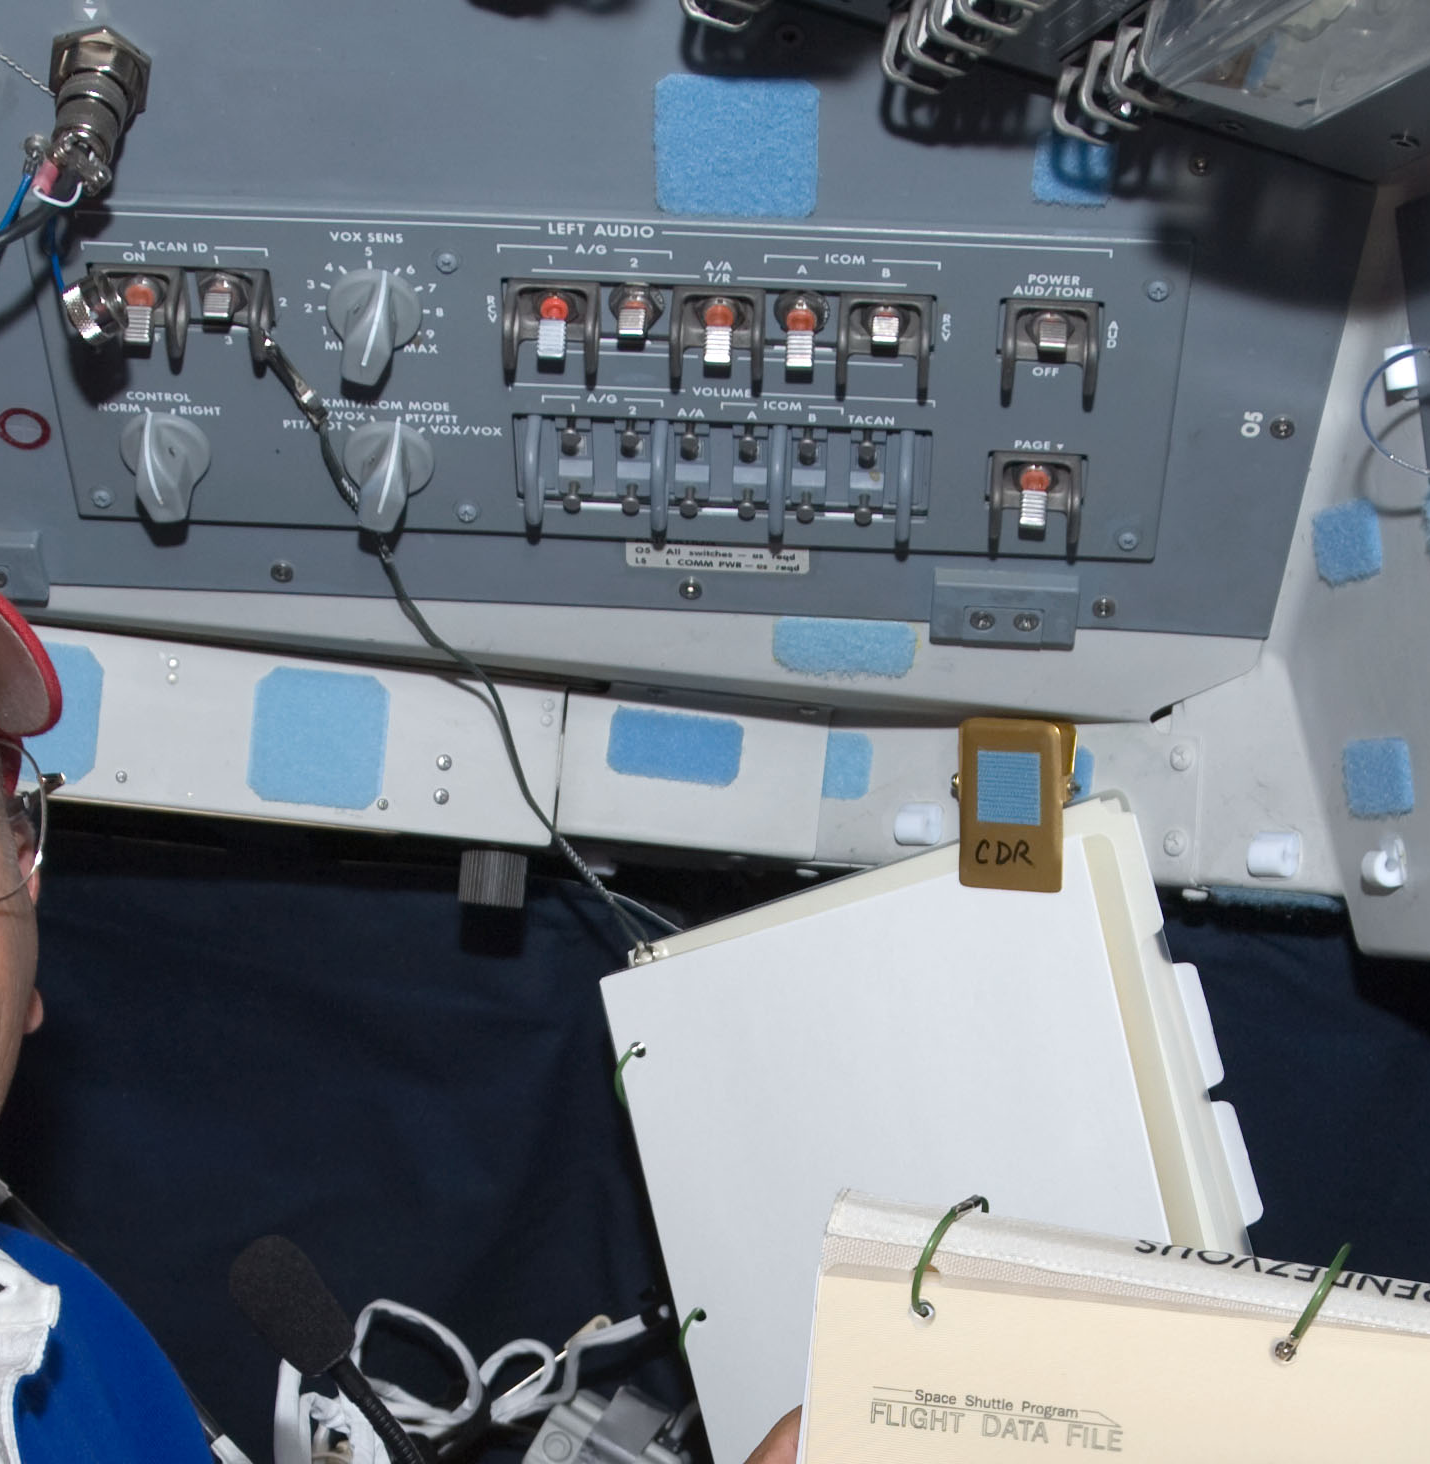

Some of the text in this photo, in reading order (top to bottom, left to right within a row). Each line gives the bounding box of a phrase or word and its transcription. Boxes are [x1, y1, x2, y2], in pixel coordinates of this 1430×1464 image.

[548, 222, 655, 239] LEFT AUDIO
[329, 231, 404, 244] VOX SENS
[139, 240, 209, 254] TACAN ID
[364, 247, 373, 257] 5
[575, 243, 608, 256] A/G
[122, 252, 146, 263] ON
[213, 254, 220, 265] 1
[547, 254, 554, 265] 1
[630, 257, 639, 268] 2
[824, 253, 866, 266] ICOM
[324, 262, 334, 273] 4
[406, 265, 416, 275] 6
[703, 260, 733, 272] A/A
[797, 264, 808, 275] A
[707, 272, 732, 284] T/R
[882, 268, 891, 279] B
[306, 280, 315, 290] 3
[1027, 274, 1081, 286] POWER
[427, 283, 437, 293] 7
[1012, 285, 1094, 298] AUD/TONE
[278, 297, 288, 308] 2
[303, 303, 313, 314] 2
[435, 307, 444, 318] 8
[486, 294, 498, 324] RCV
[941, 313, 953, 343] RCV
[426, 329, 435, 339] 9
[1106, 320, 1120, 349] AUD
[224, 335, 234, 346] 3
[403, 344, 439, 355] MAX
[1032, 366, 1059, 377] OFF
[126, 391, 192, 403] CONTROL
[692, 387, 752, 399] VOLUME
[587, 394, 618, 405] A/G
[98, 402, 141, 413] NORM
[179, 405, 221, 417] RIGHT
[408, 401, 450, 413] MODE
[628, 406, 637, 416] 2
[763, 400, 802, 412] ICOM
[405, 413, 458, 424] PTT/PTT
[677, 408, 705, 418] A/A
[747, 410, 758, 420] A
[808, 412, 817, 423] B
[848, 414, 895, 426] TACAN
[430, 425, 503, 437] VOX/VOX
[1014, 439, 1051, 451] PAGE
[689, 549, 733, 559] switches
[677, 558, 714, 568] COMM
[718, 561, 742, 569] PWR
[974, 840, 1034, 868] CDR
[914, 1389, 1079, 1419] Space Shuttle Program
[870, 1401, 1123, 1452] FLIGHT DATA FILE
